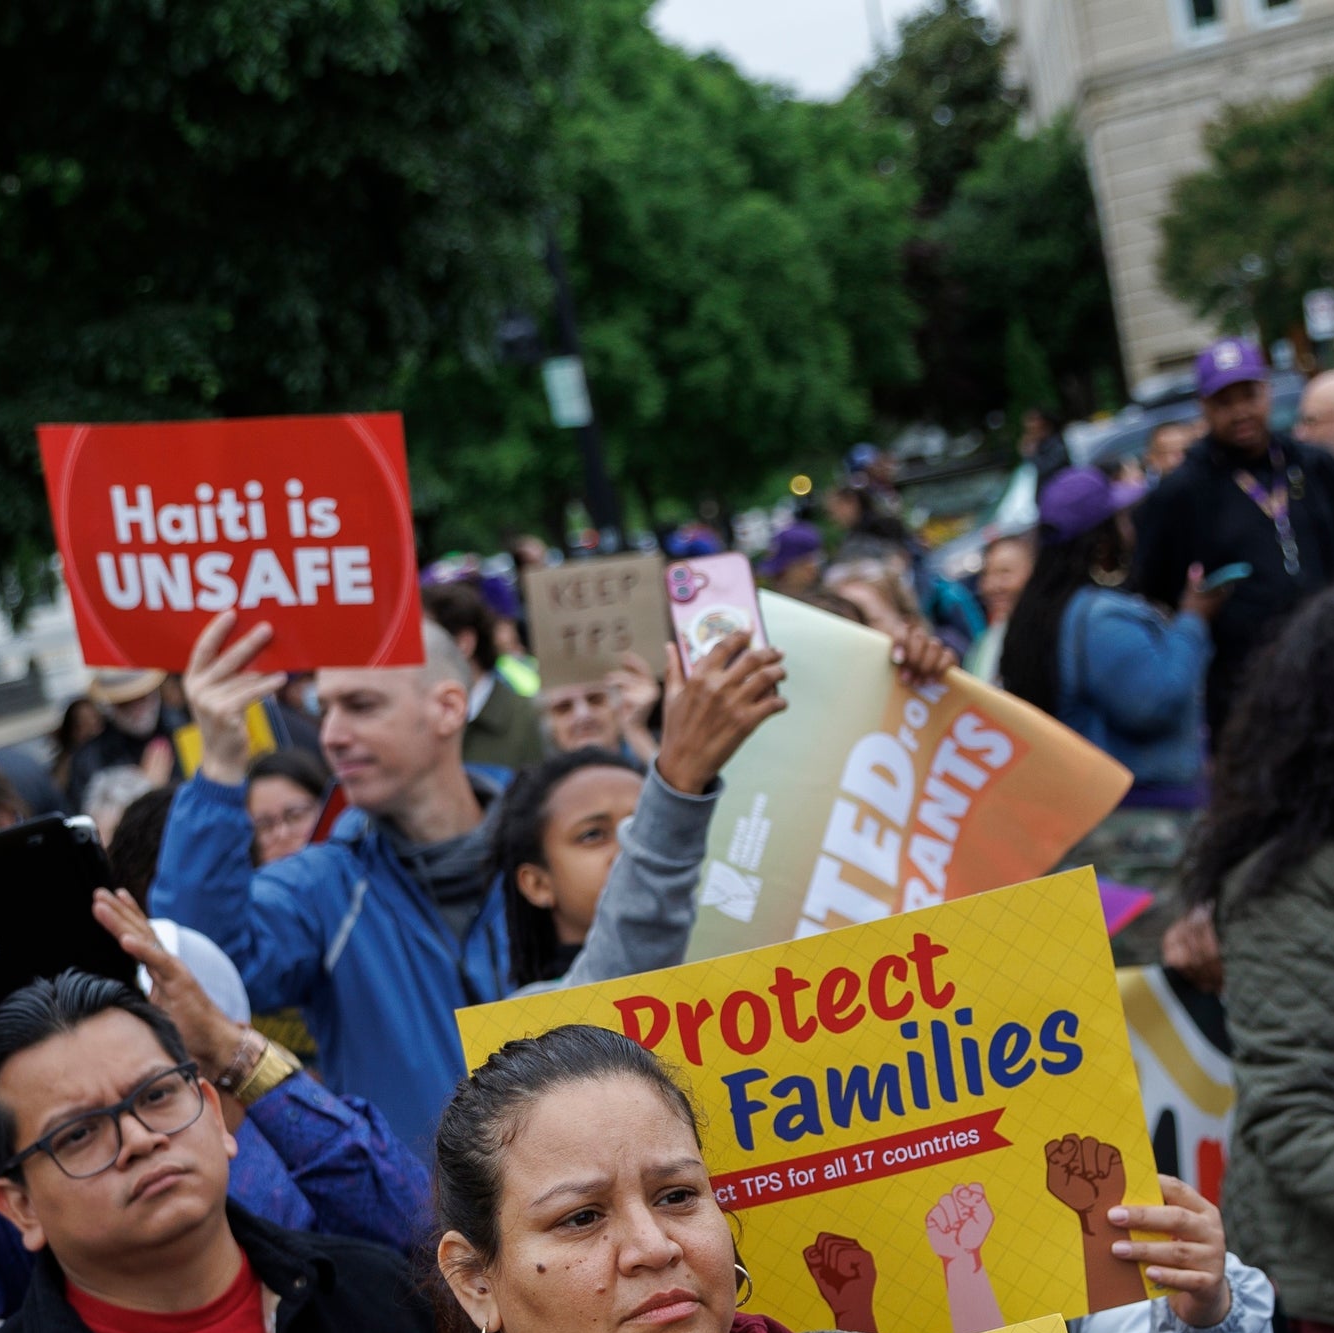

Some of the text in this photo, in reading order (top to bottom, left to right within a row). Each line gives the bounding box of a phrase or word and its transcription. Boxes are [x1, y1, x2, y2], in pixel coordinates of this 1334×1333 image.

[96, 545, 374, 612] UNSAFE
[109, 478, 340, 545] Haiti is
[794, 731, 915, 940] TED
[903, 710, 1014, 913] RANTS
[613, 932, 956, 1066] Protect
[720, 1007, 1083, 1150] Families
[740, 1171, 784, 1198] TPS
[787, 1165, 816, 1188] for
[823, 1157, 848, 1180] all
[851, 1150, 875, 1174] 17
[881, 1127, 981, 1166] countries
